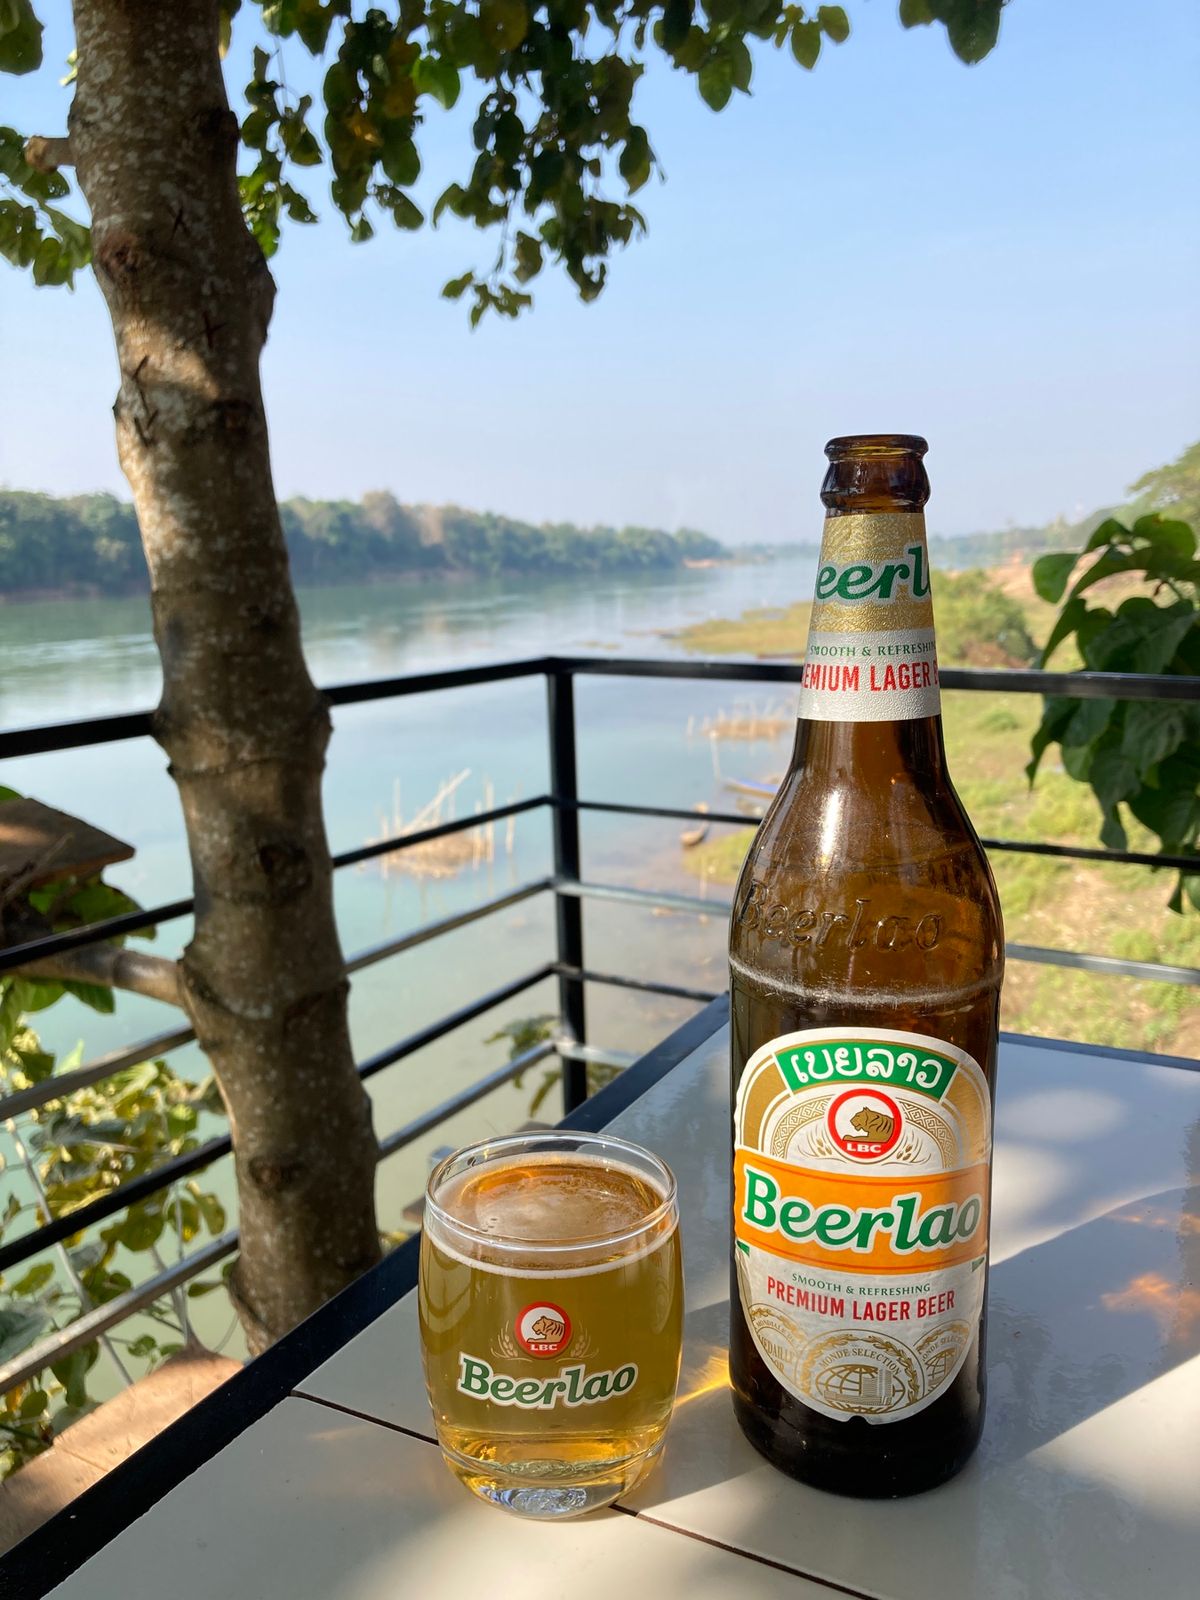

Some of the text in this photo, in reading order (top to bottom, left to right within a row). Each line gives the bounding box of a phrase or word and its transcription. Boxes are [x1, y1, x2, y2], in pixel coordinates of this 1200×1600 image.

[816, 546, 932, 600] eerl
[810, 645, 856, 657] SMOOTH
[862, 646, 871, 656] &
[801, 663, 860, 692] EMIUM
[869, 661, 931, 692] LAGER
[739, 879, 943, 951] Beerlao
[790, 1046, 943, 1089] ເບຍລາວ
[846, 1143, 882, 1154] LBC
[743, 1168, 981, 1251] Beerlao
[767, 1275, 955, 1322] PREMIUM LAGER BEER
[792, 1273, 931, 1296] SMOOTH & REFRESHING
[529, 1343, 558, 1352] LBC
[820, 1348, 902, 1376] MONDE SELECTION
[459, 1356, 637, 1406] Beerlao
